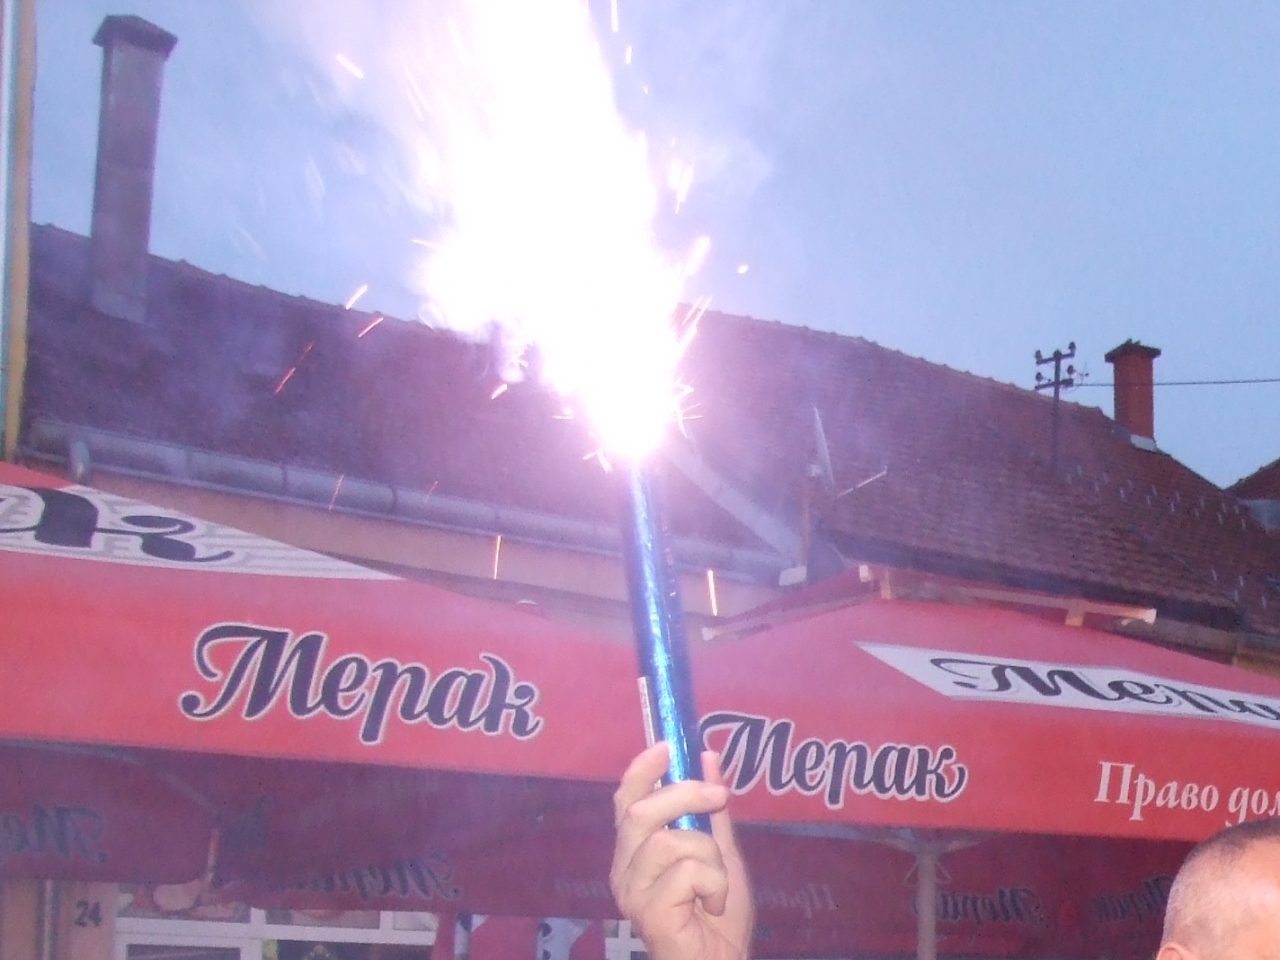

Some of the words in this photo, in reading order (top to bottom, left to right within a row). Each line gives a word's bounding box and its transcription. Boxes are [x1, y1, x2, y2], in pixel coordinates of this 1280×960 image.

[180, 622, 544, 745] Мерак
[698, 710, 968, 809] Мерак
[1094, 761, 1219, 821] Право
[74, 898, 102, 928] 24
